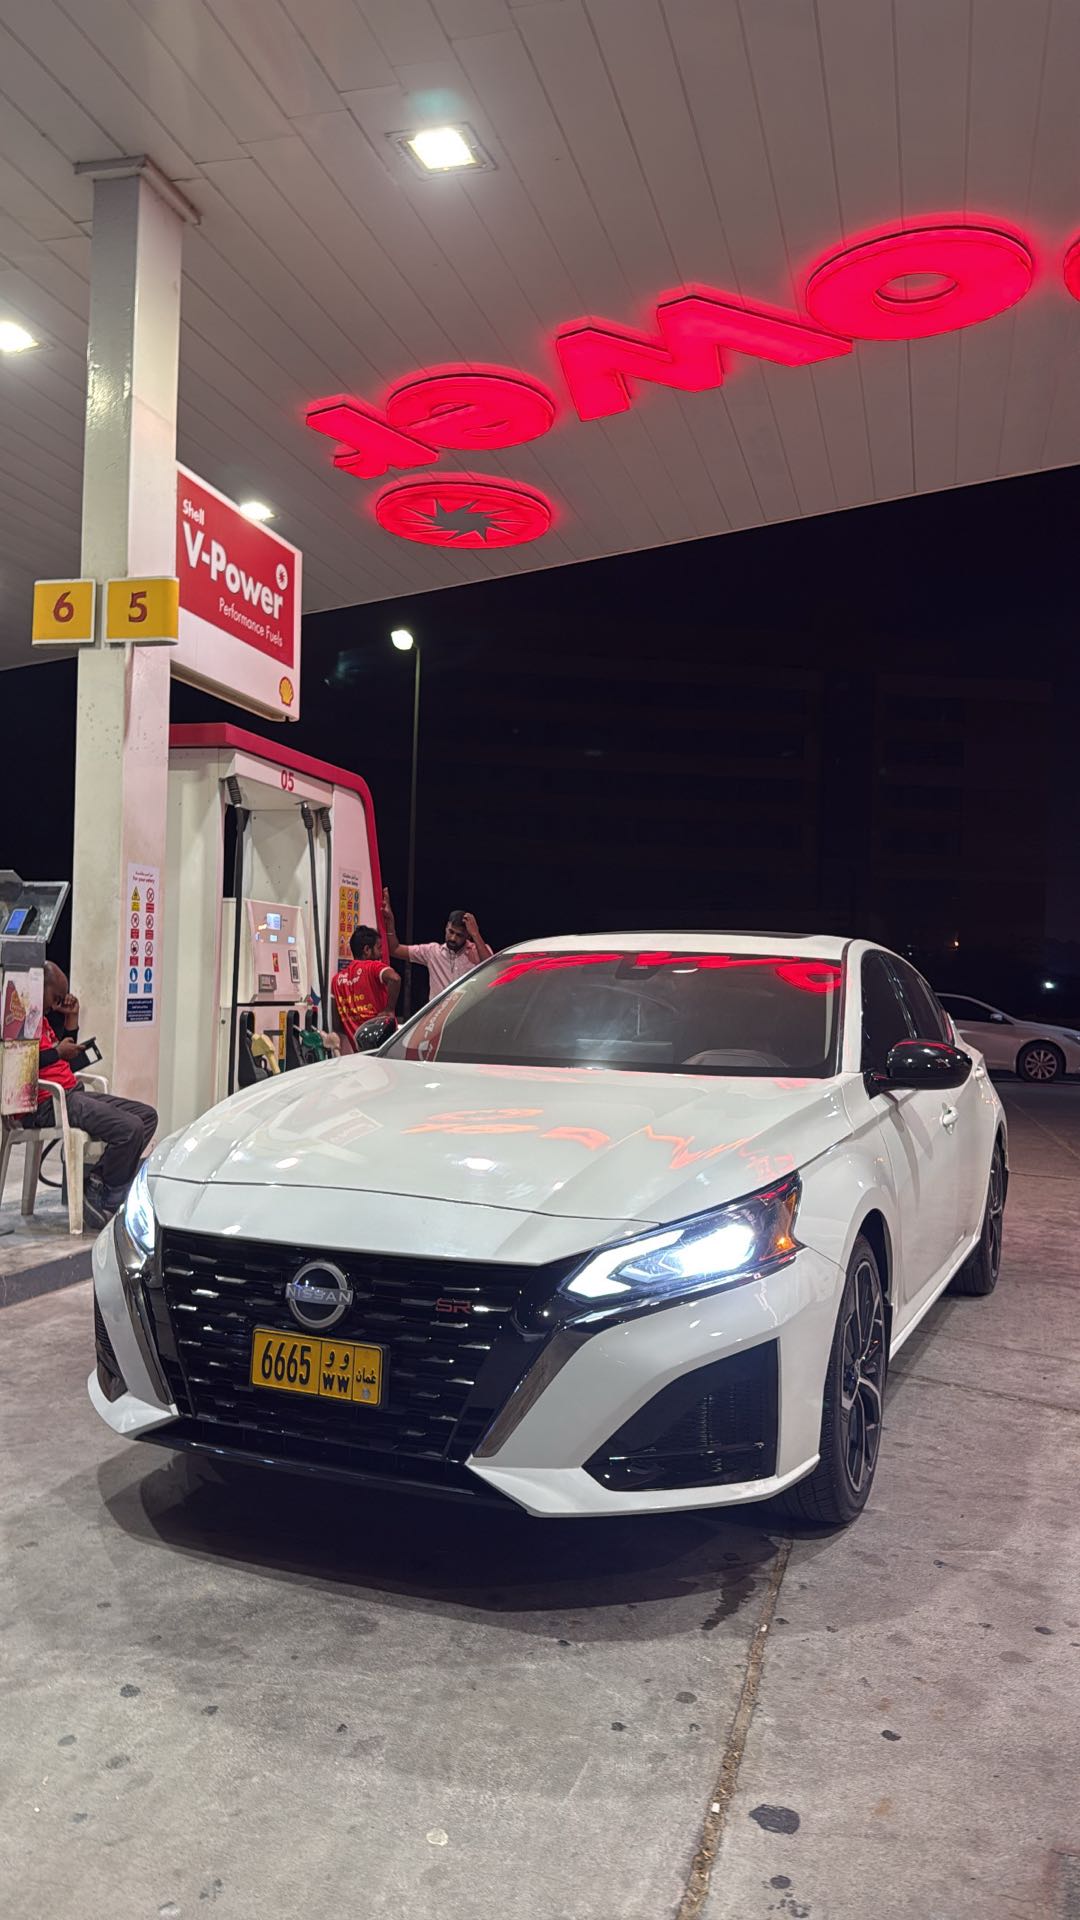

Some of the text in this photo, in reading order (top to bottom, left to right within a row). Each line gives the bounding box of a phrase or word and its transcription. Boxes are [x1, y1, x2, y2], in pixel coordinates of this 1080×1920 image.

[305, 216, 1080, 479] ower
[183, 499, 205, 526] Shell
[183, 521, 283, 619] V-Power
[53, 591, 75, 622] 6
[128, 591, 147, 623] 5
[219, 597, 283, 647] Performance Fuels
[281, 769, 294, 791] 05
[286, 1283, 352, 1304] NISSAN
[435, 1298, 471, 1314] SR
[261, 1339, 311, 1386] 6665
[322, 1371, 350, 1393] WW
